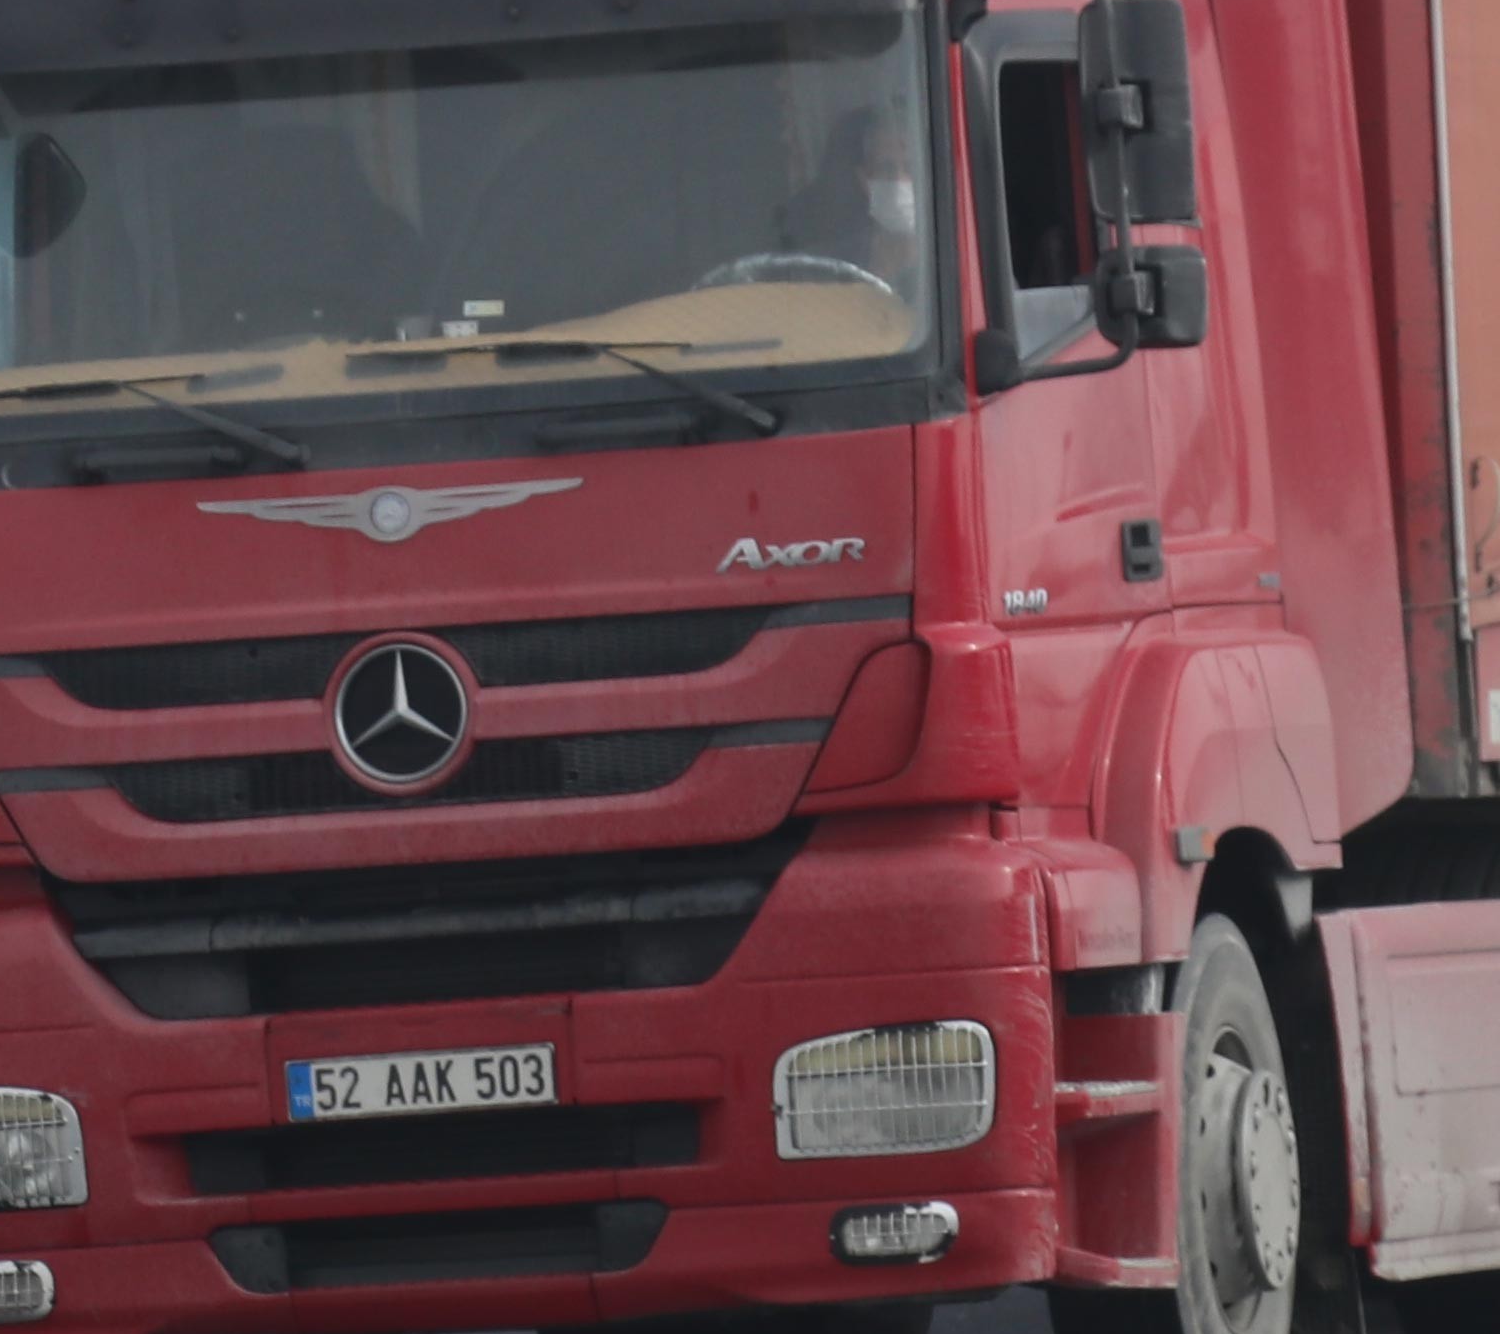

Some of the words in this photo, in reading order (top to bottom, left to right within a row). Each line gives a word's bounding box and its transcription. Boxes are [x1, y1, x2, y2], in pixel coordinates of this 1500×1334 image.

[1002, 587, 1049, 617] 1840
[314, 1067, 362, 1112] 52
[385, 1059, 457, 1107] AAK
[473, 1053, 546, 1101] 503
